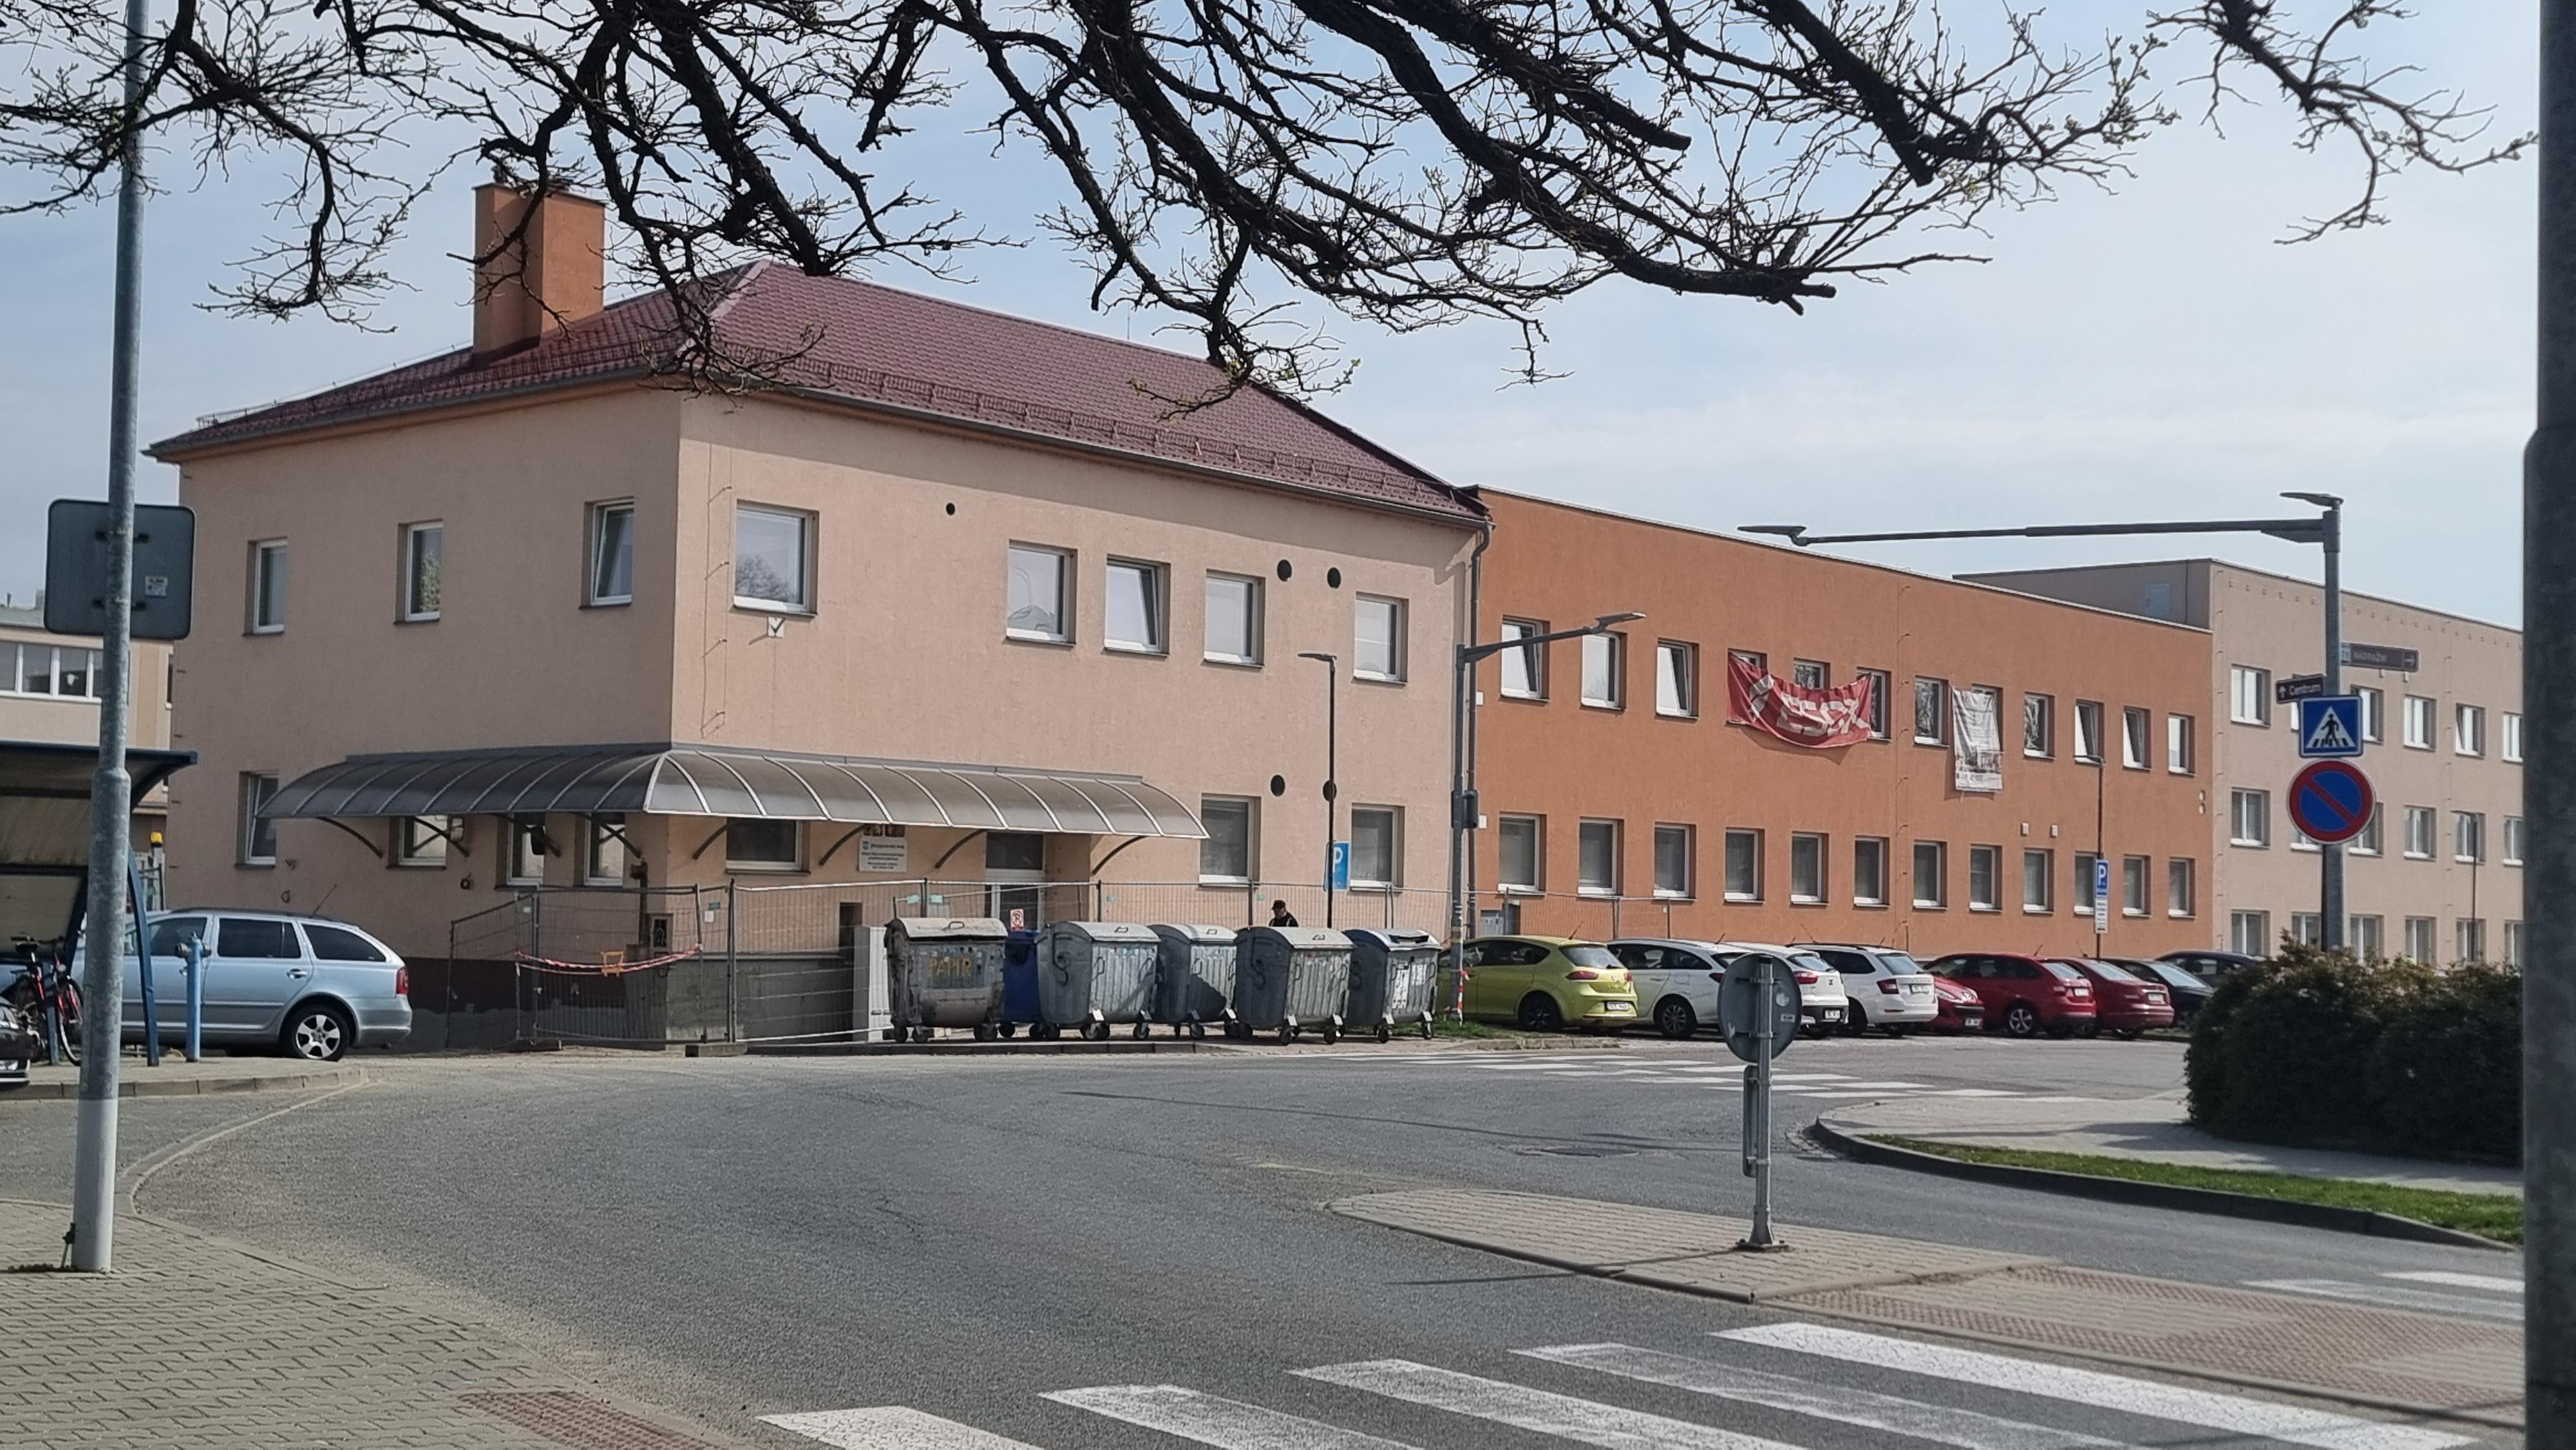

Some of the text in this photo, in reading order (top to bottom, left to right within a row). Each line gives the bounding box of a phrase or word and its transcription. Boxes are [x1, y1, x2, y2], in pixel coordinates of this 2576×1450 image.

[2289, 684, 2321, 696] Centrum
[1332, 847, 1343, 873] P
[2098, 865, 2106, 885] P
